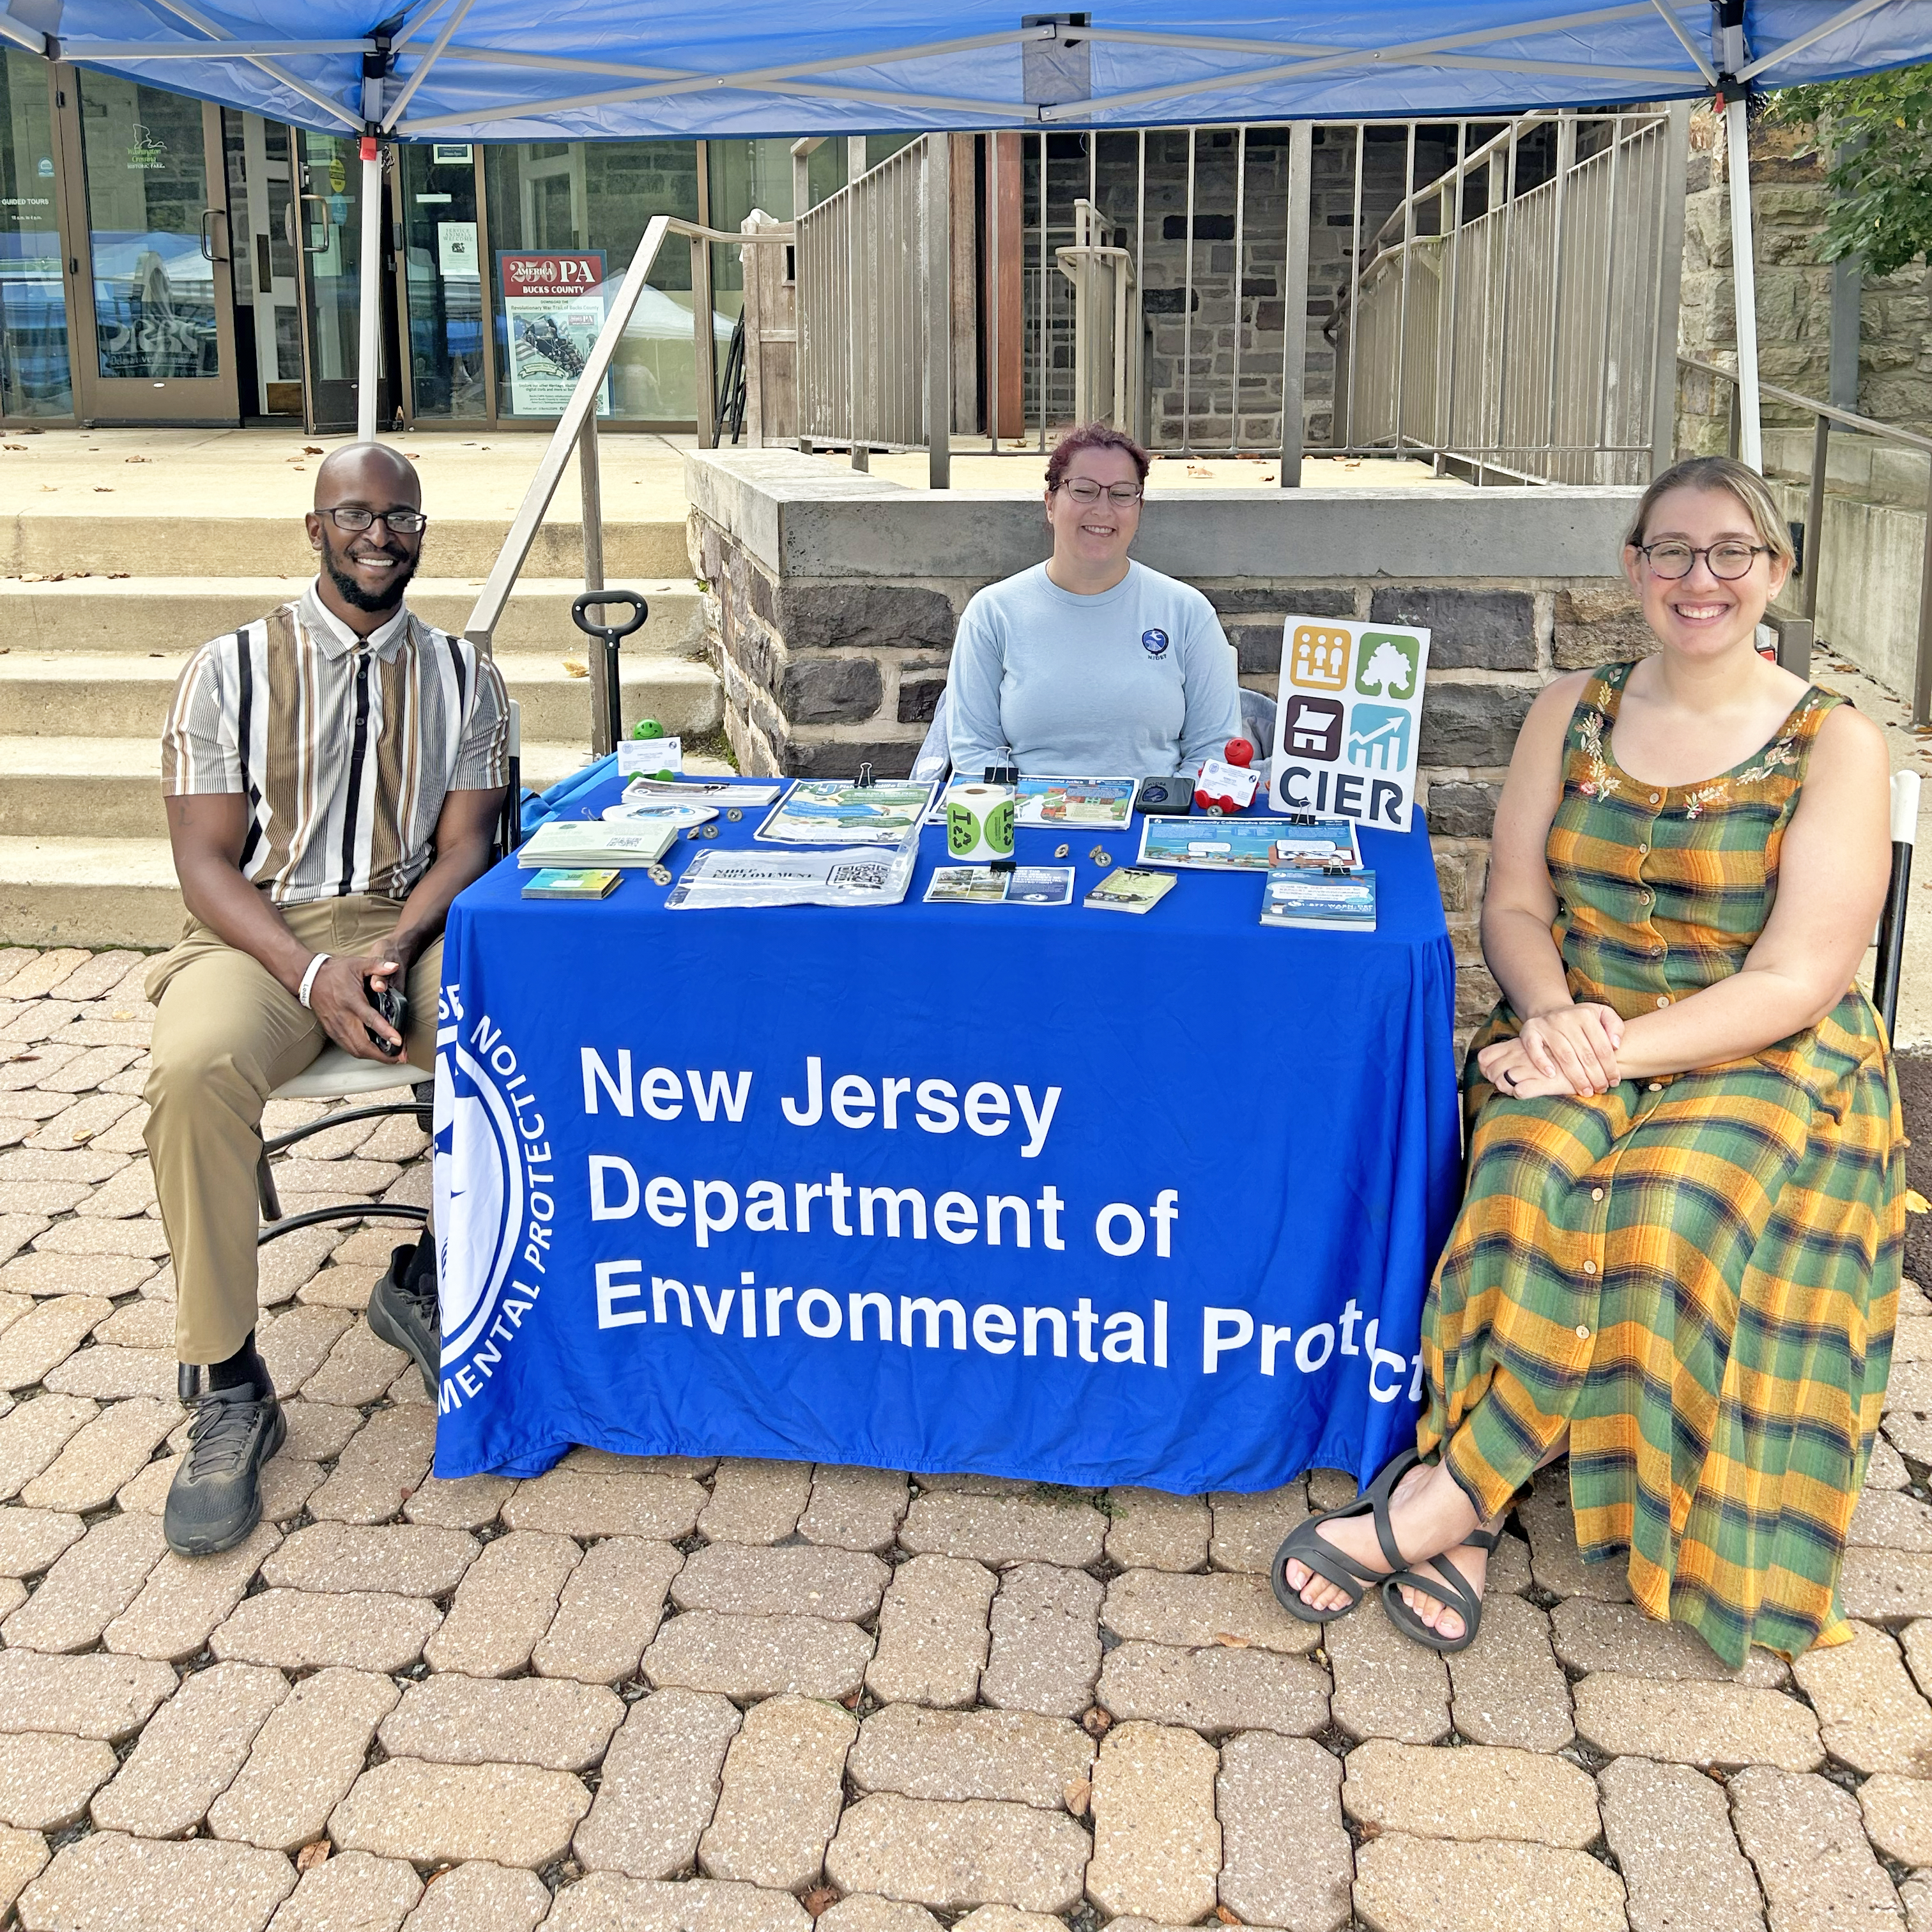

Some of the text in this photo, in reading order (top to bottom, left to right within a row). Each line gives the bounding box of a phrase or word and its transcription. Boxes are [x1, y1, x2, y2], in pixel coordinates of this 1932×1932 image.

[510, 260, 596, 283] 250 PA
[516, 267, 553, 275] AMERICA
[523, 286, 585, 294] BUCKS COUNTY
[1280, 767, 1404, 825] CIER
[580, 1046, 1062, 1158] New Jersey
[470, 1015, 556, 1274] PROTECTION
[587, 1154, 1179, 1258] Department of
[595, 1259, 1168, 1368] Environmental
